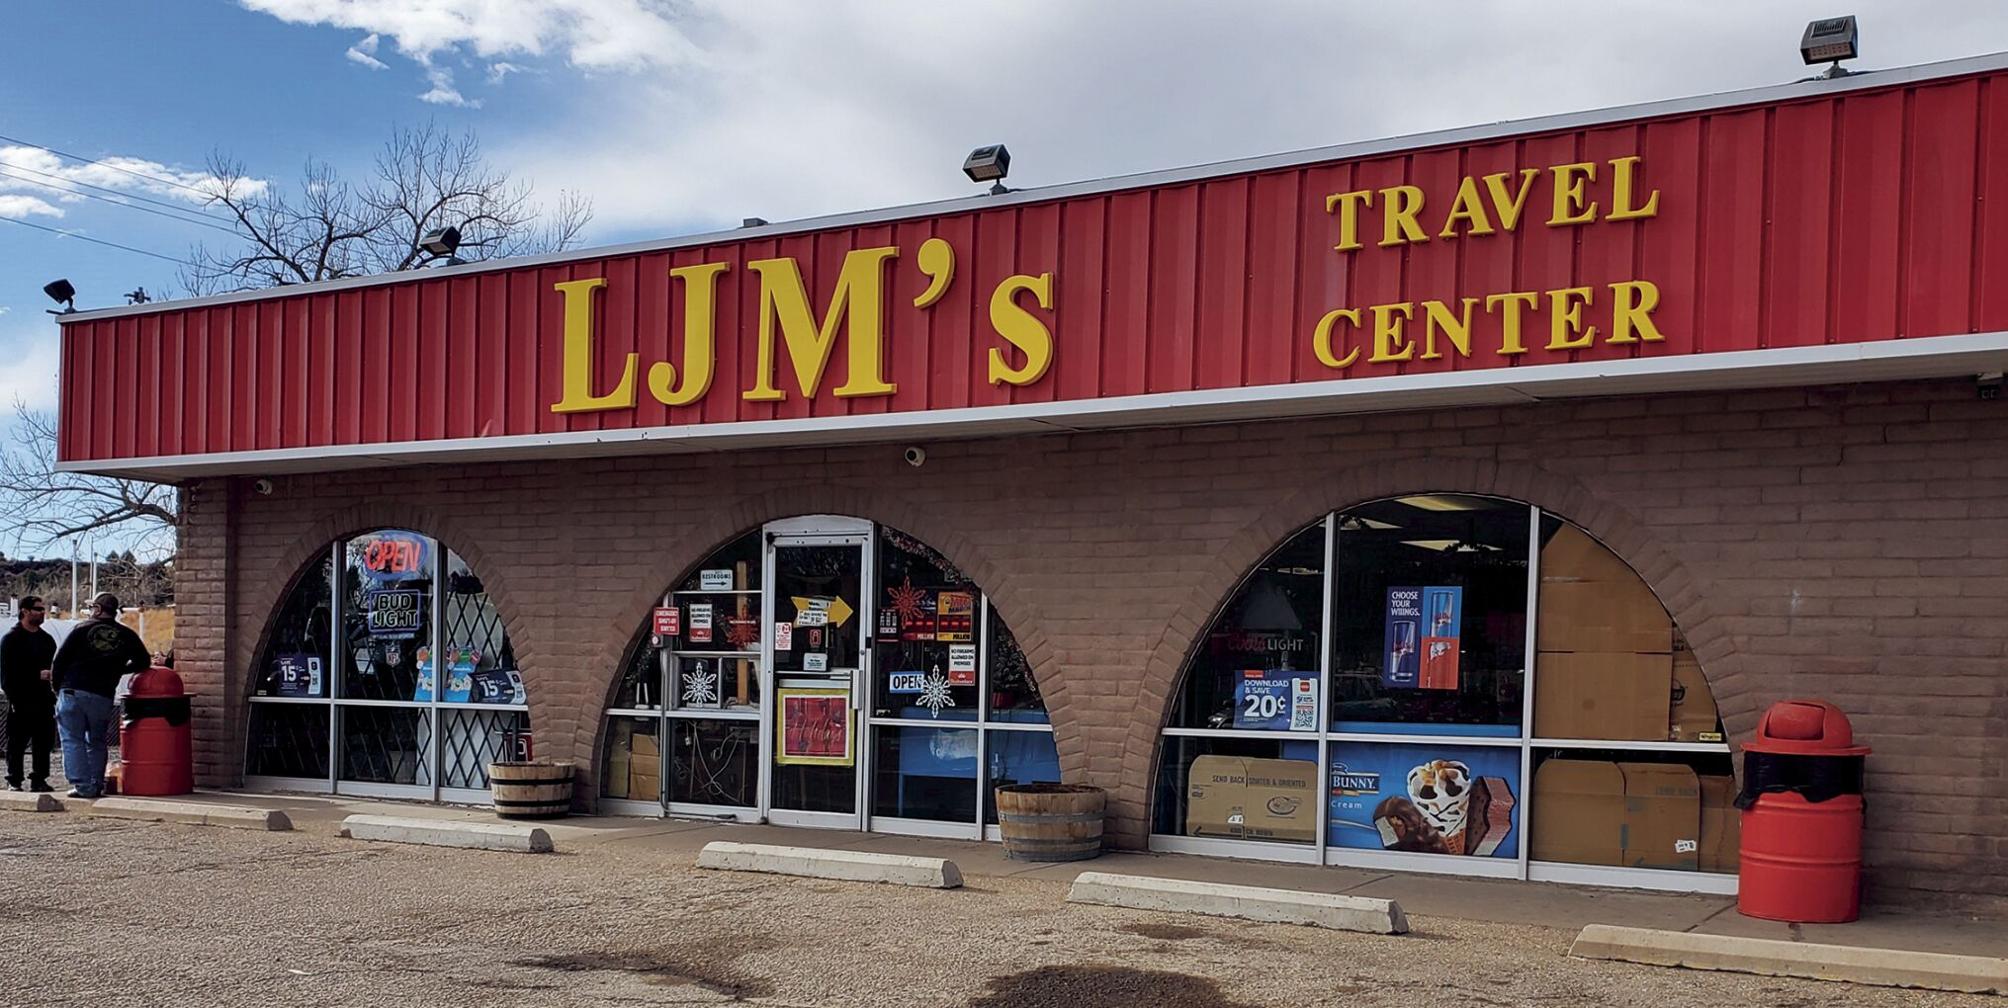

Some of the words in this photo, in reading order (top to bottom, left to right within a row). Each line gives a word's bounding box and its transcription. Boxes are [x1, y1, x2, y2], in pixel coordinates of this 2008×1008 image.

[1325, 156, 1660, 250] TRAVEL
[550, 238, 1055, 414] LJM's
[1313, 280, 1665, 369] CENTER
[366, 540, 421, 572] OPEN
[377, 593, 412, 610] BUD
[1391, 591, 1418, 600] CHOOSE
[373, 610, 417, 628] LIGHT
[1267, 639, 1304, 652] LIGHT
[893, 675, 922, 690] OPEN
[1244, 679, 1289, 688] DOWNLOAD
[1244, 694, 1286, 717] 20¢
[1212, 774, 1228, 783] SEND
[1229, 775, 1245, 784] BACK
[1279, 778, 1306, 788] ORIENTED
[1331, 800, 1362, 809] Cream
